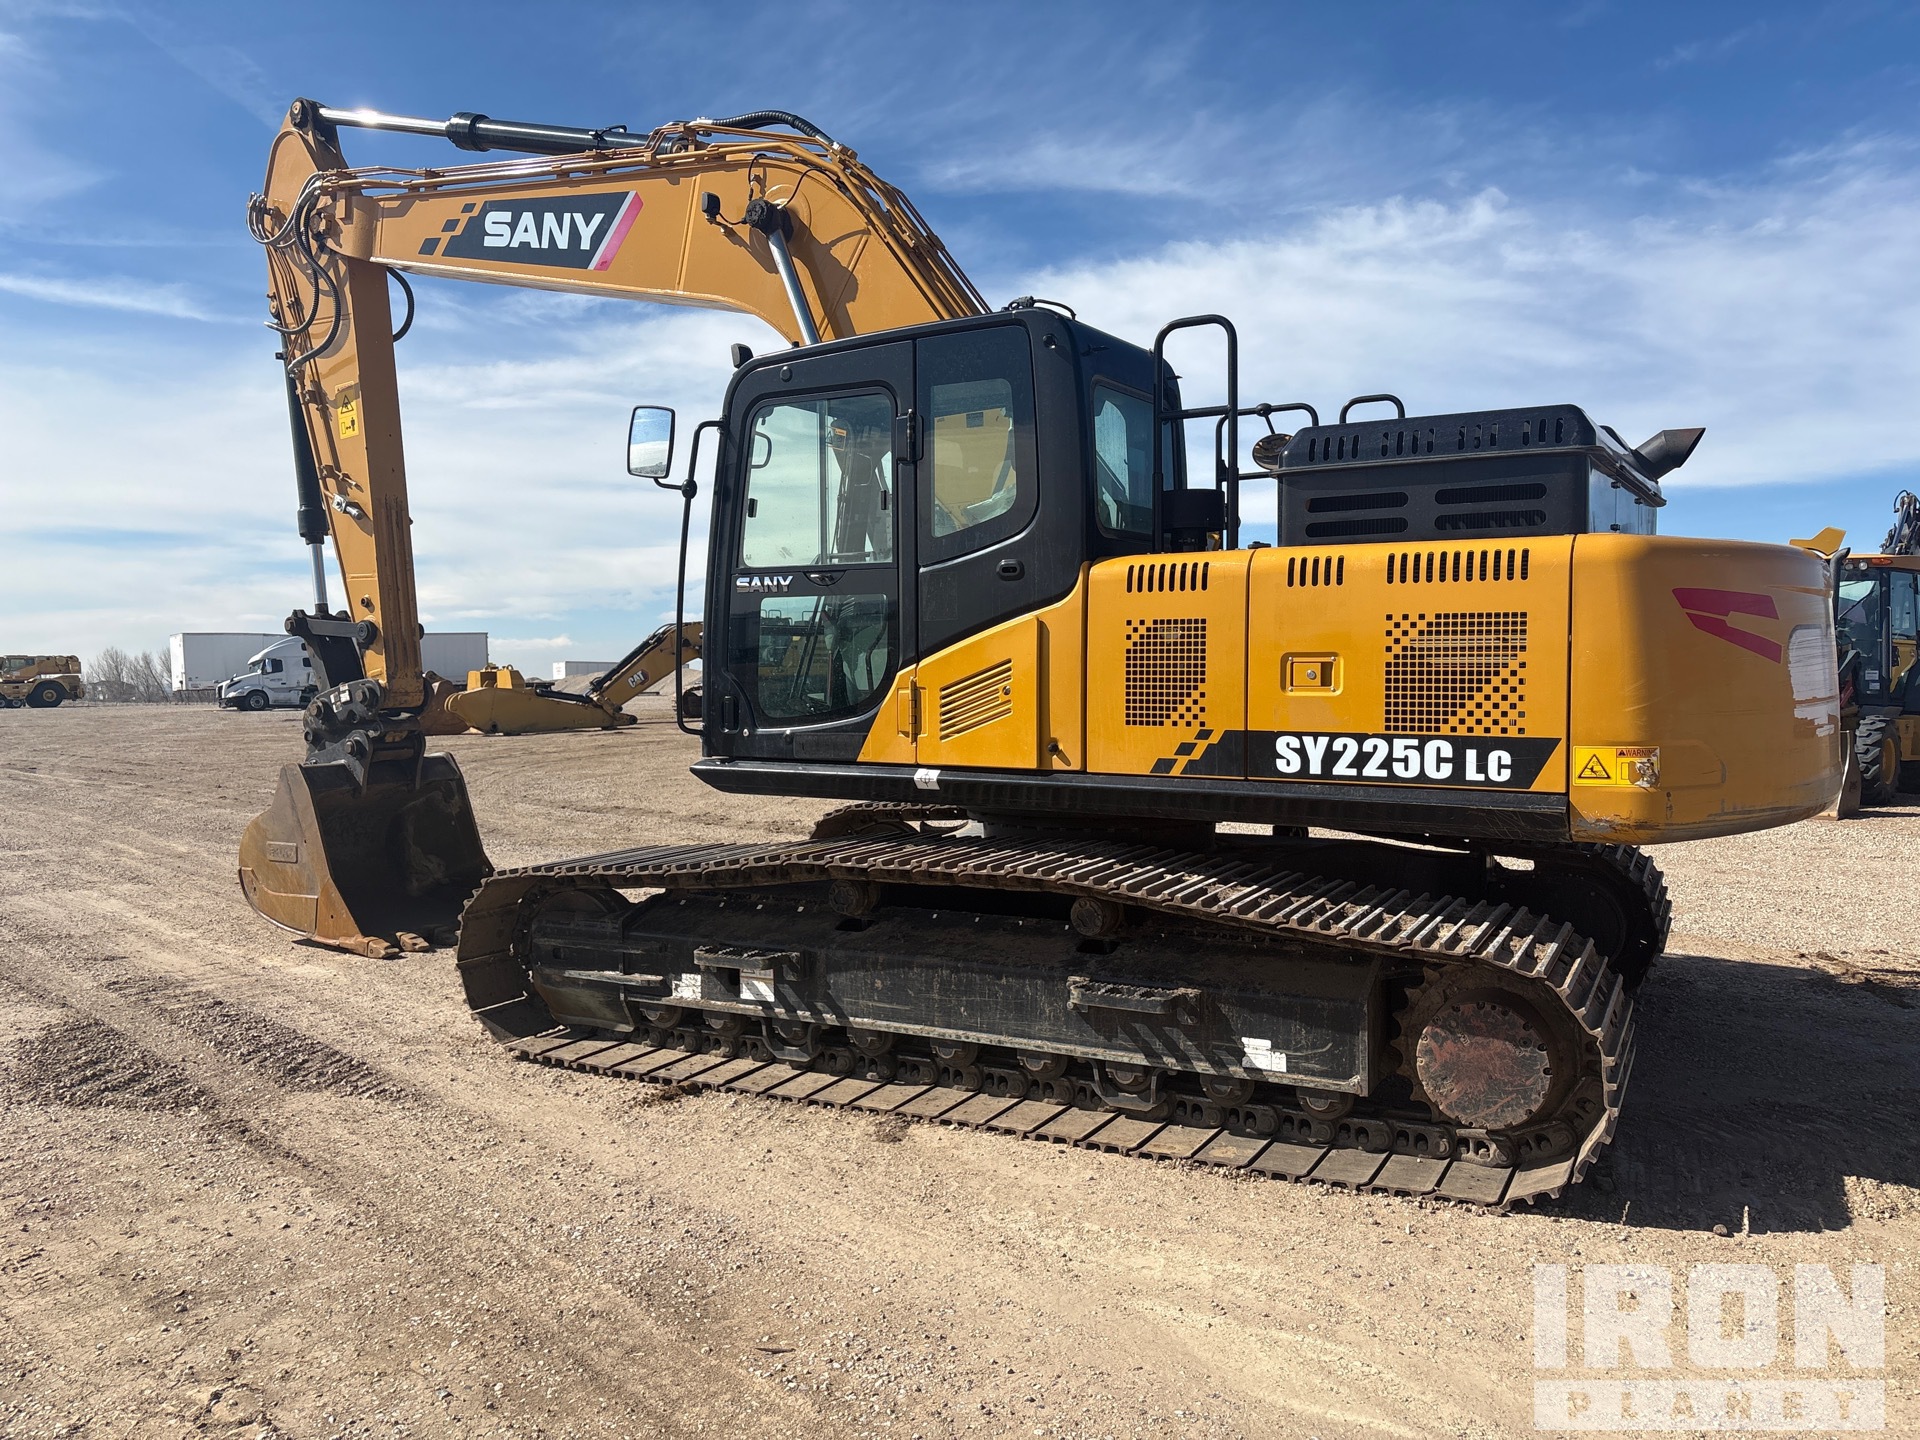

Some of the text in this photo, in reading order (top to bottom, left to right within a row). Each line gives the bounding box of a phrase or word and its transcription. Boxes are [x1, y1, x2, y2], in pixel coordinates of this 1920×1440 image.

[483, 211, 605, 250] SANY
[736, 575, 793, 593] SANY
[627, 670, 645, 688] CAT
[1275, 735, 1512, 782] SY225C LC
